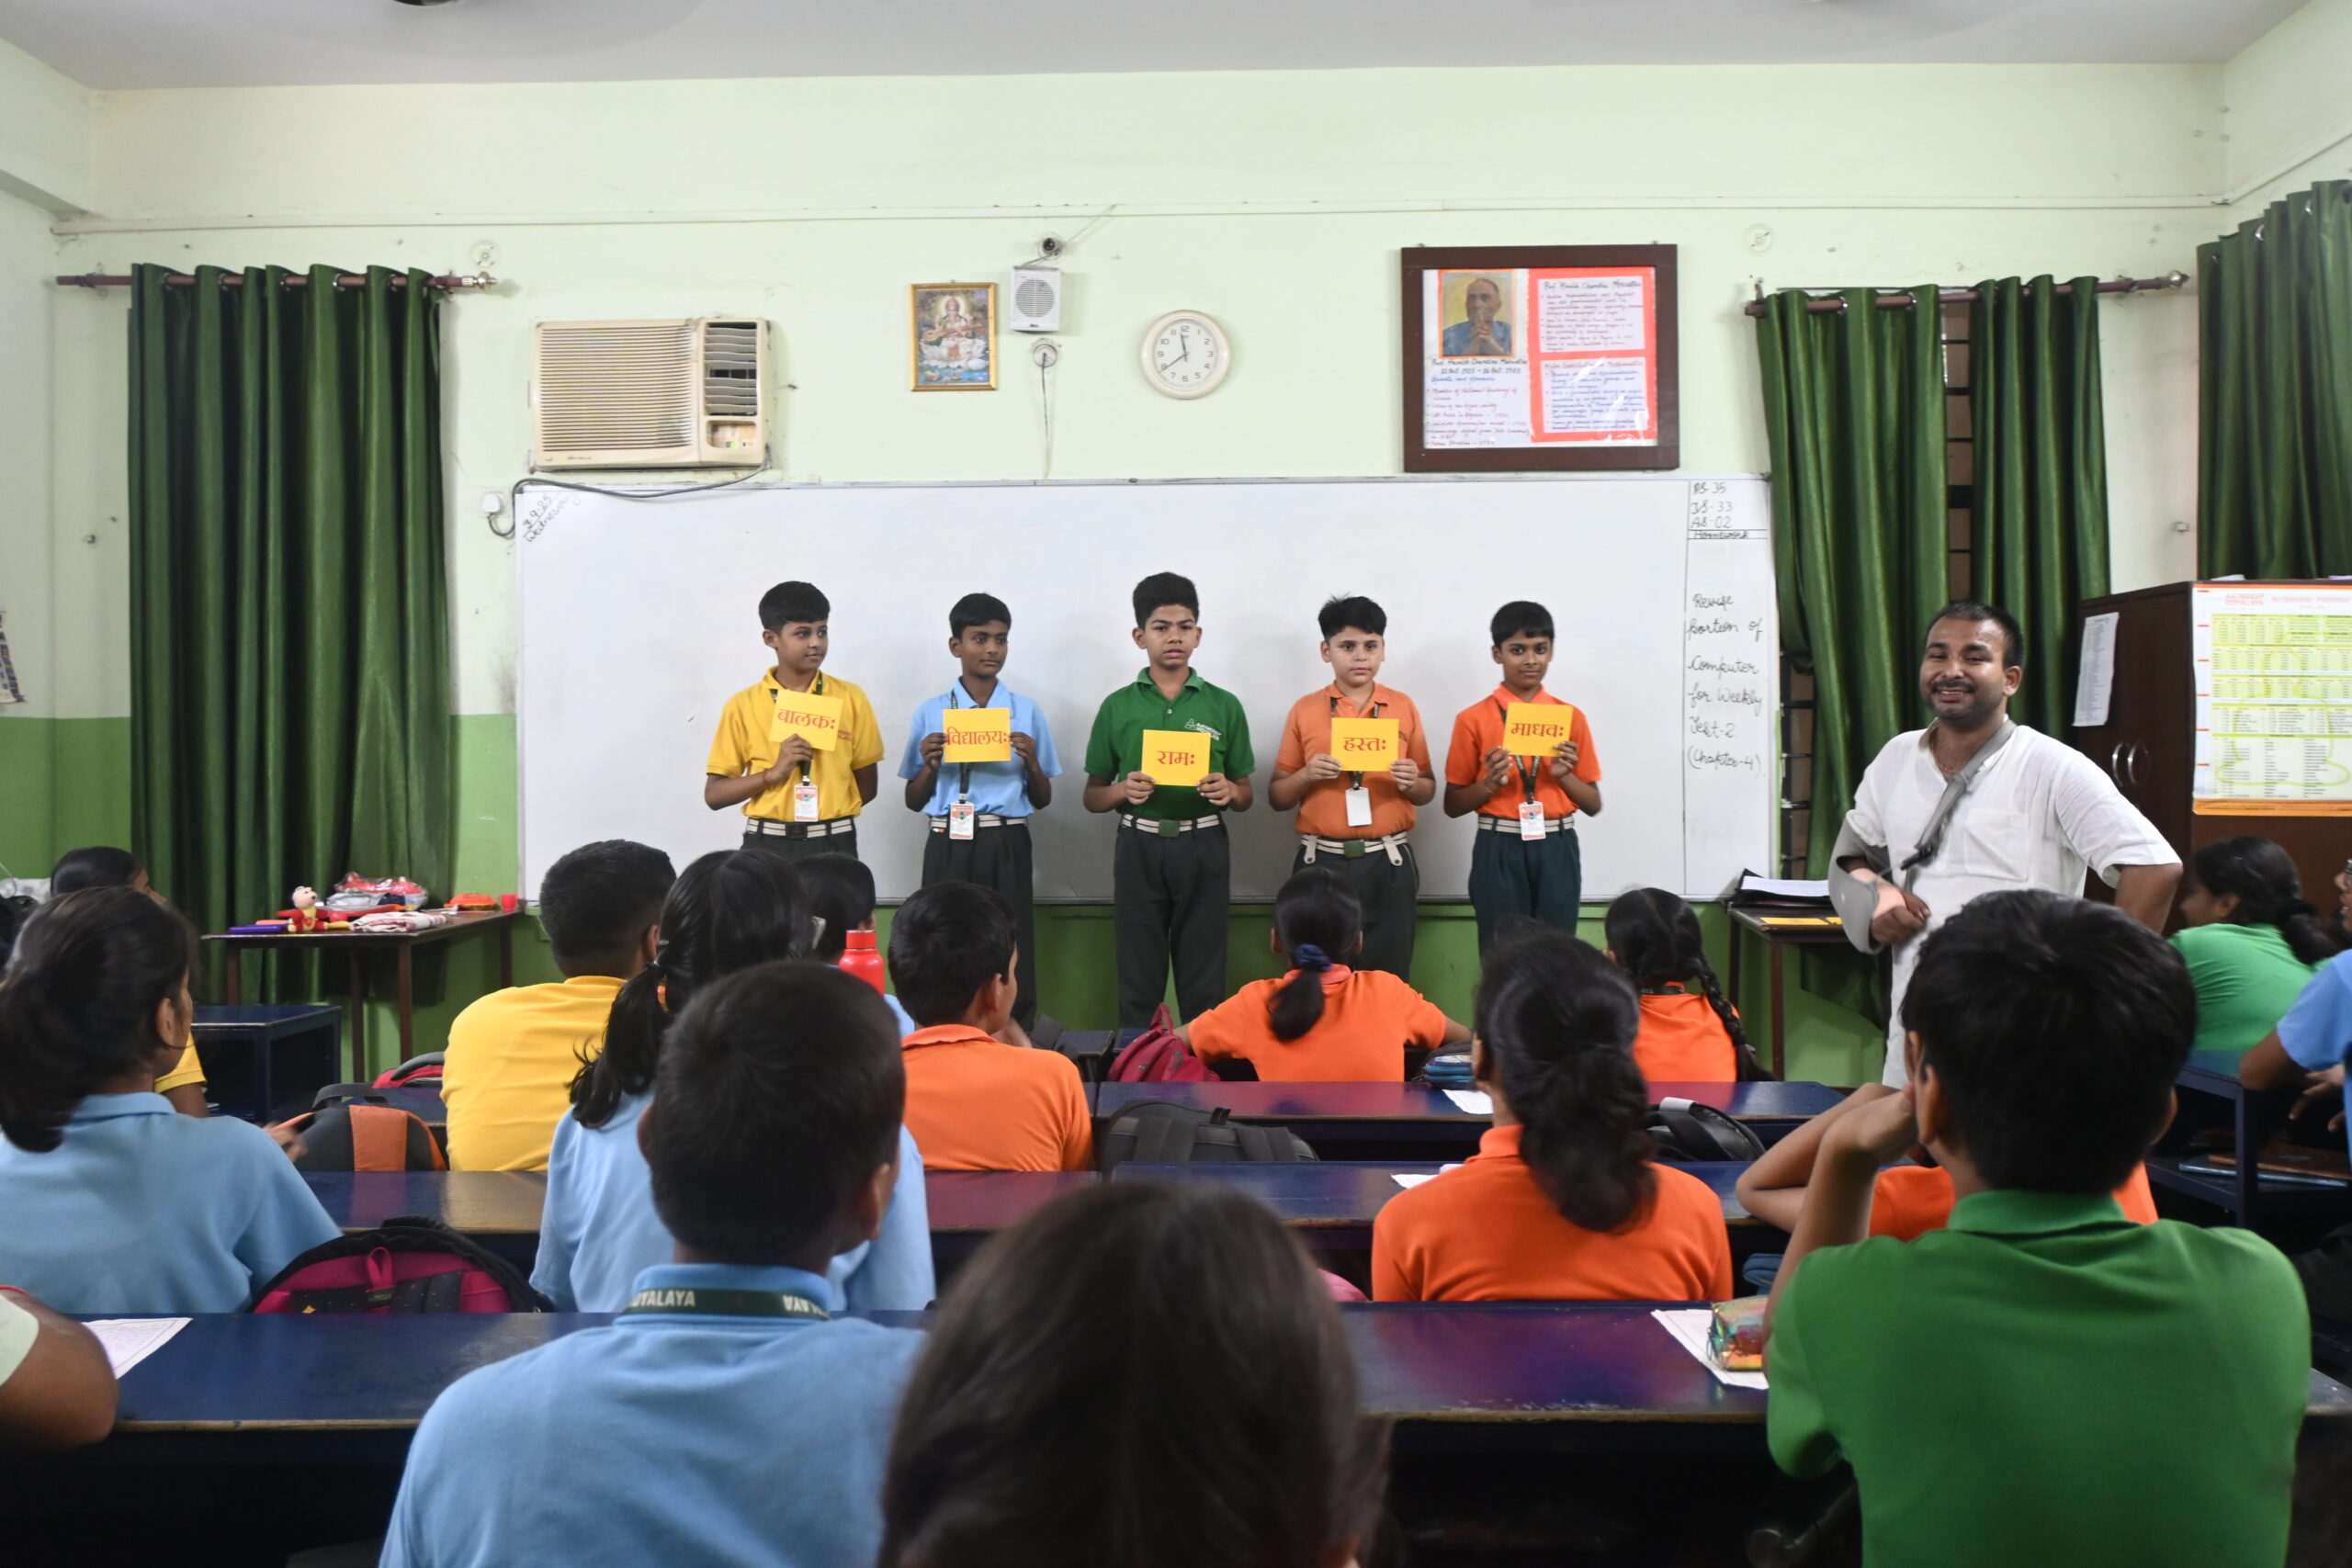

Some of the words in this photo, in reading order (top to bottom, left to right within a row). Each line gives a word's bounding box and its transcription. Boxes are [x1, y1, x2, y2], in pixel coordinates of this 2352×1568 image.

[1748, 617, 1763, 642] of
[1687, 682, 1712, 708] for
[947, 726, 1007, 745] विद्यालयः
[1510, 722, 1564, 738] माधवः
[1343, 737, 1386, 751] हस्तः
[1158, 750, 1195, 765] रामः
